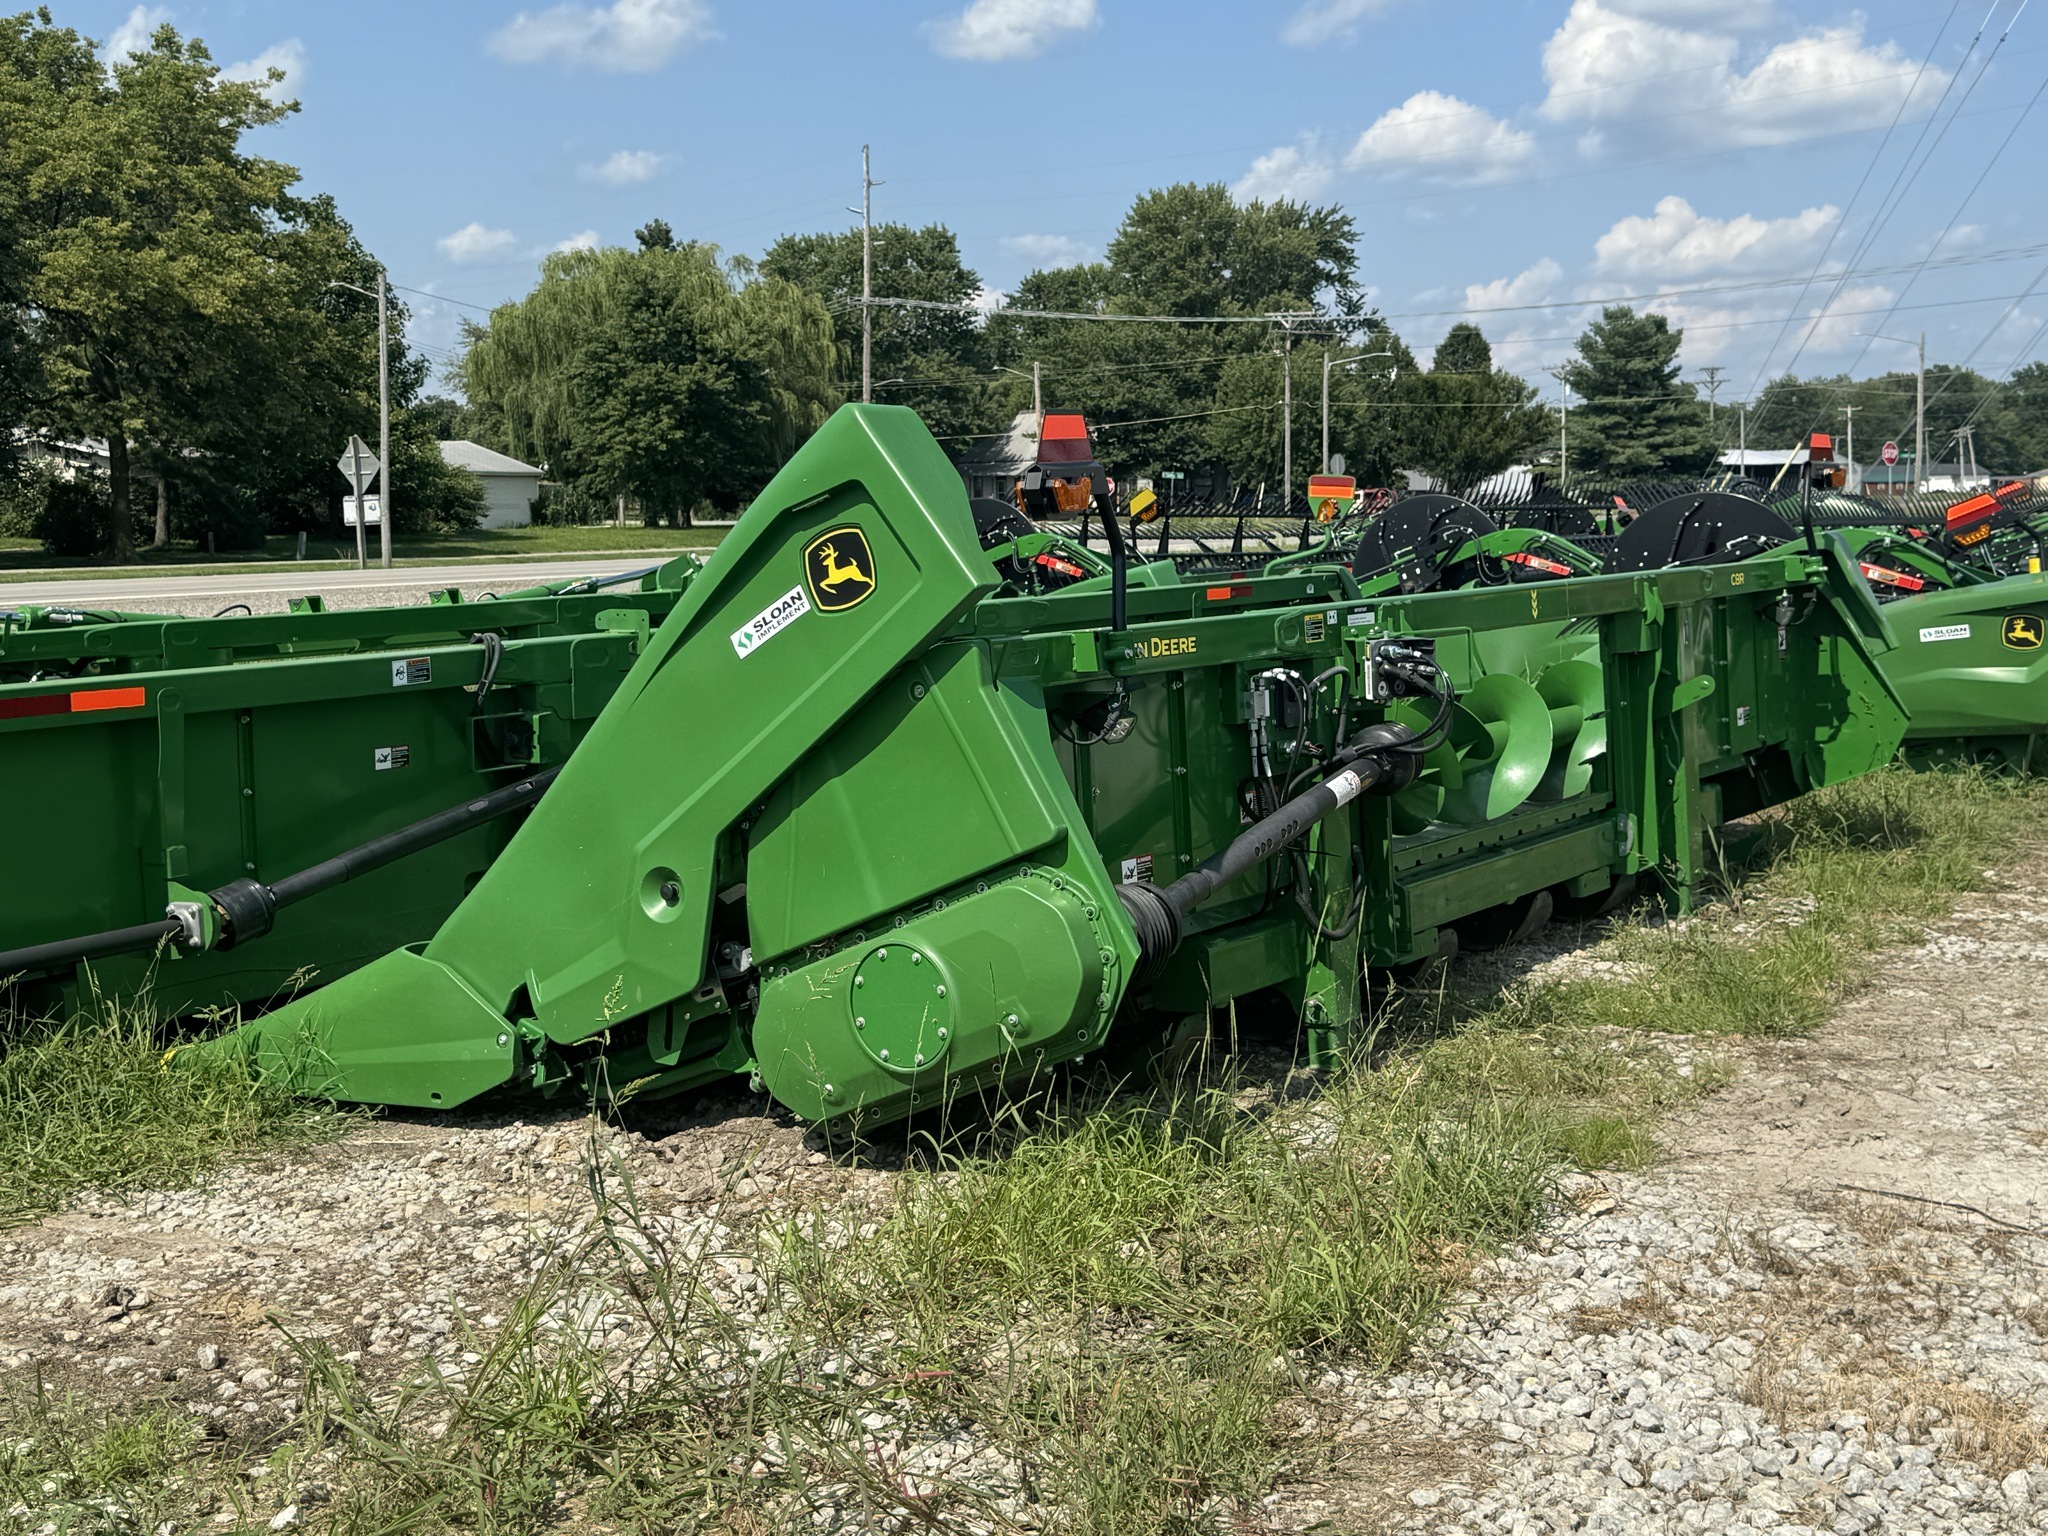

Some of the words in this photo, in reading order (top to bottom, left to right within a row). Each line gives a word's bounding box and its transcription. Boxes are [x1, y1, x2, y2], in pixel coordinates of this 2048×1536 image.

[1884, 448, 1897, 459] STOP
[753, 591, 803, 633] SLOAN
[757, 601, 806, 641] IMPLEMENT
[1934, 627, 1967, 635] SLOAN
[1151, 636, 1197, 657] DEERE
